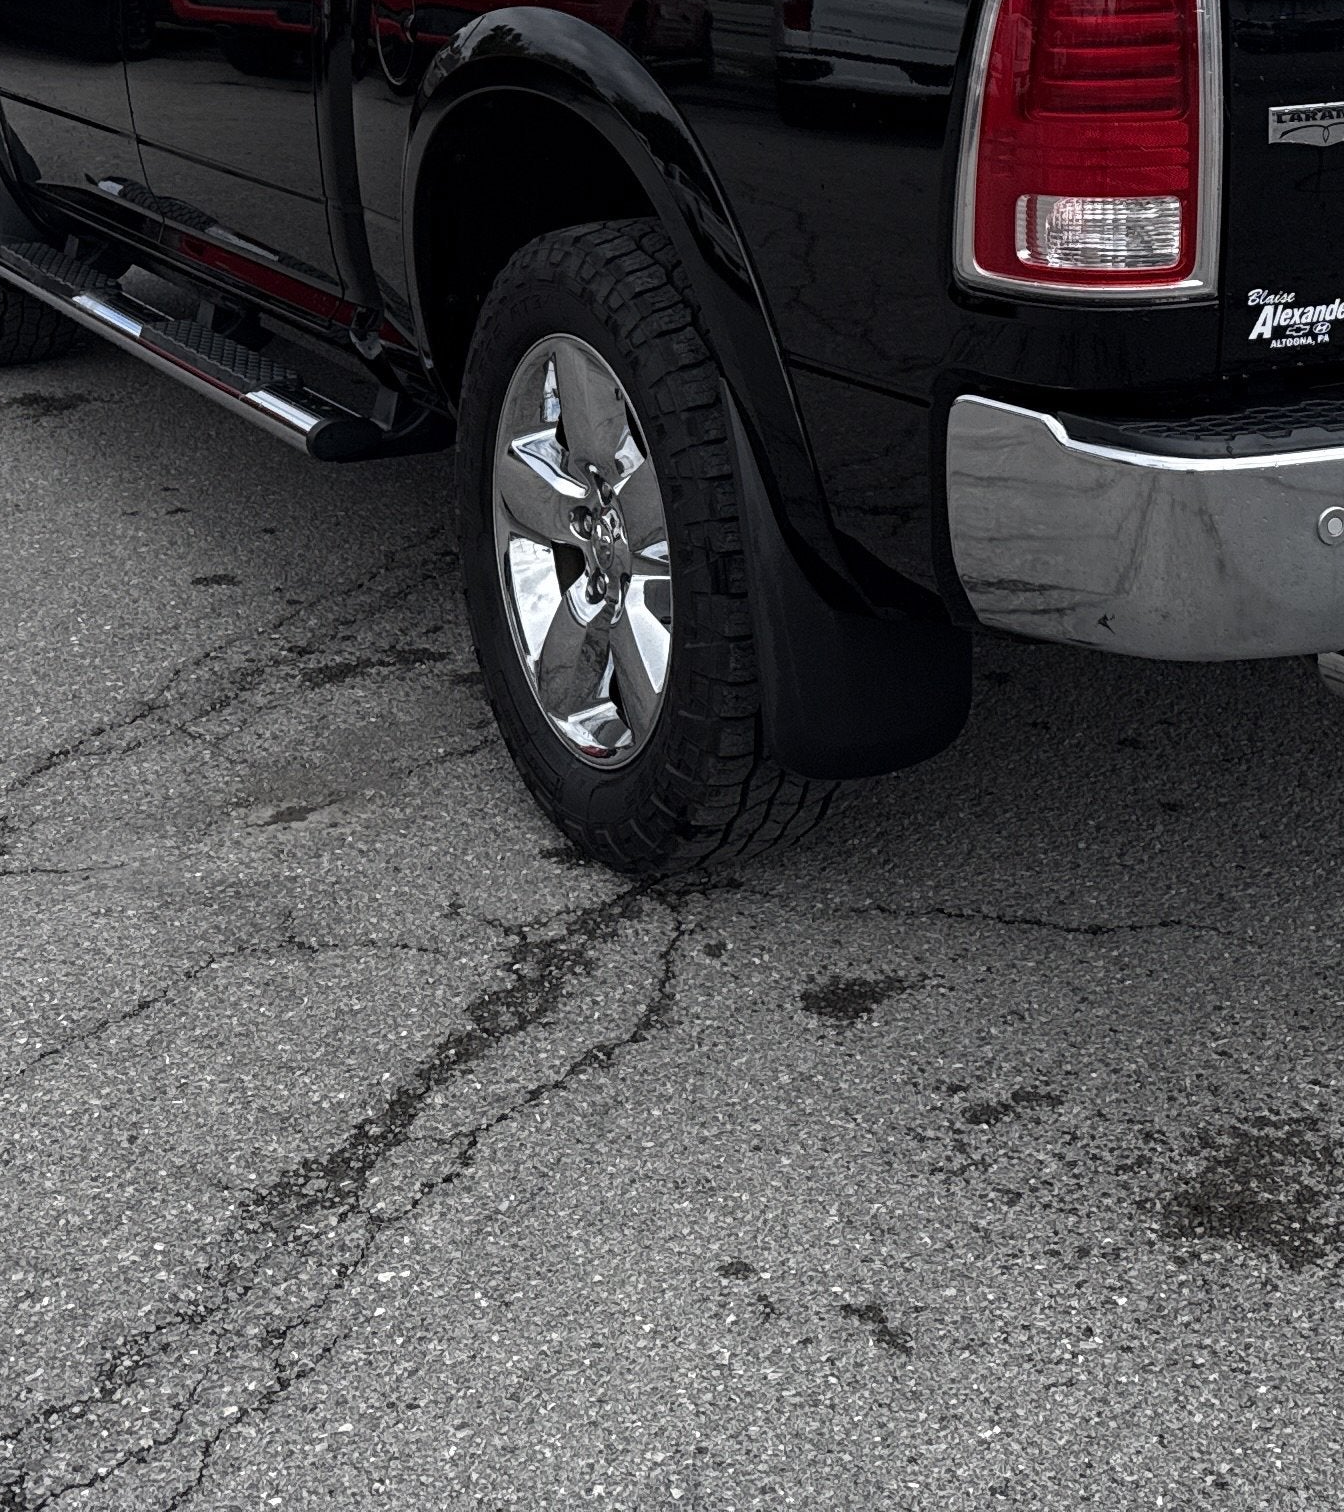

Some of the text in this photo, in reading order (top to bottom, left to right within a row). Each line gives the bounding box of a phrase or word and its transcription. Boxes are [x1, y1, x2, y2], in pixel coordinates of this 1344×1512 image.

[1247, 288, 1296, 306] Blaise
[1270, 334, 1330, 349] ALTOONA, PA
